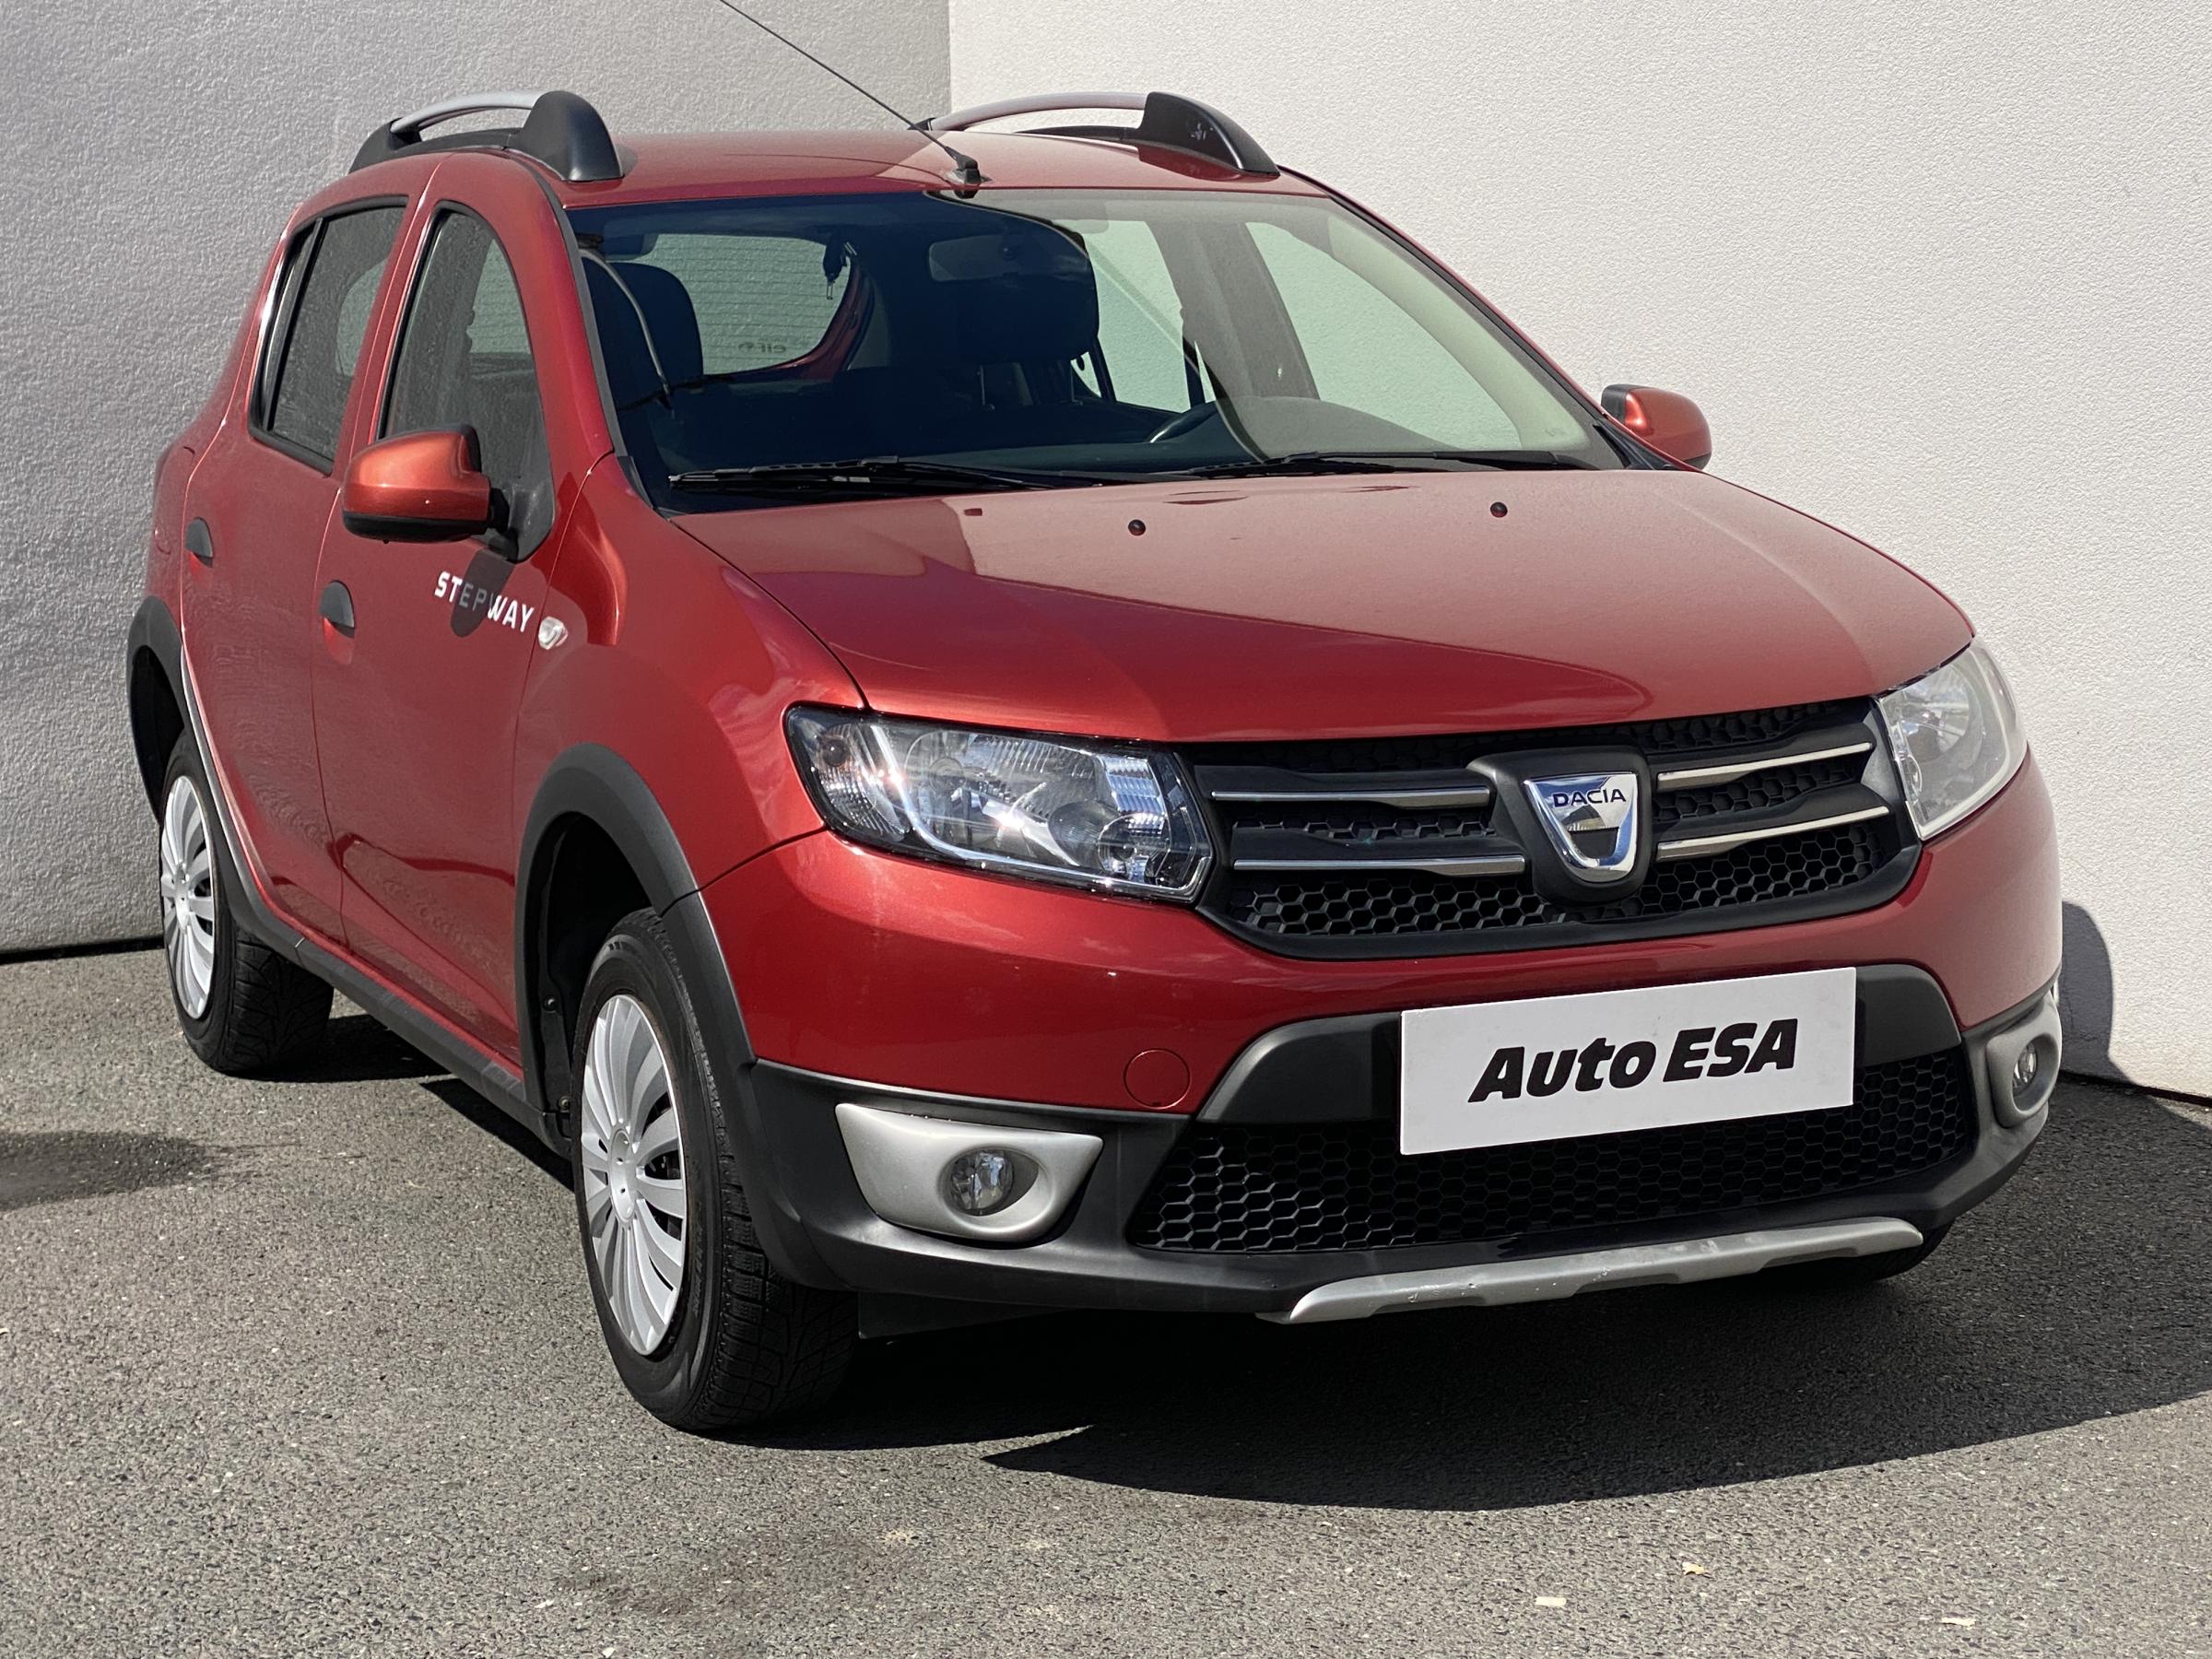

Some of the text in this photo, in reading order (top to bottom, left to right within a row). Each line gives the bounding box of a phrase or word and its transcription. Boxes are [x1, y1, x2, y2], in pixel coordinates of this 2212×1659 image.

[434, 571, 535, 632] STEPWAY
[1552, 788, 1627, 807] DACIA
[1467, 1018, 1798, 1103] Auto ESA
